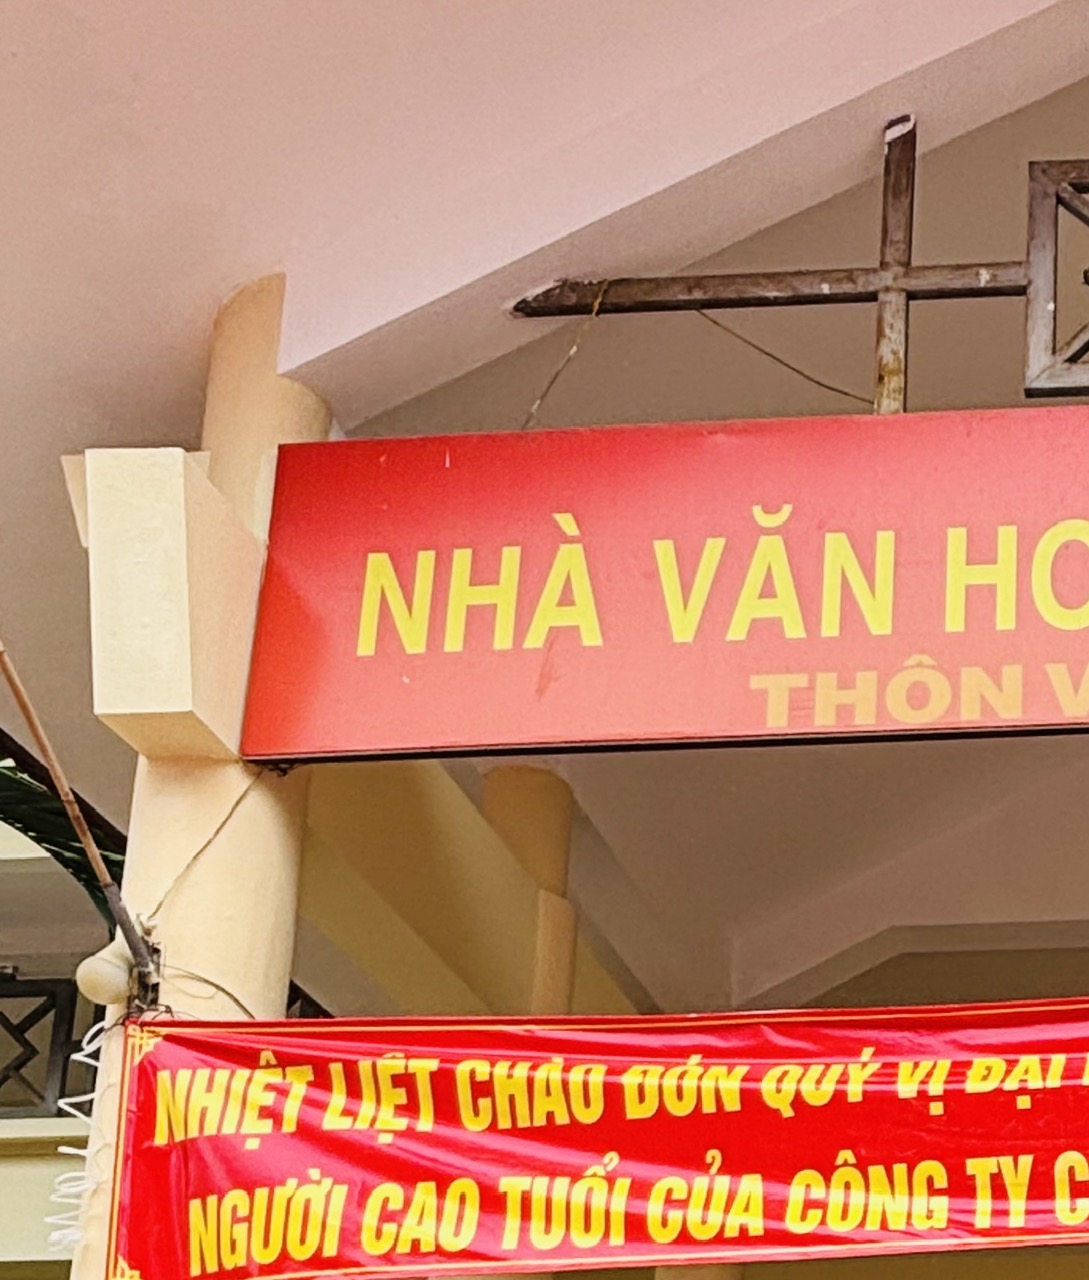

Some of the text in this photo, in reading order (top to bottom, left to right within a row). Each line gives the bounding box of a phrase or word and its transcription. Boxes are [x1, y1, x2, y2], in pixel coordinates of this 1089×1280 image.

[357, 513, 603, 657] NHÀ
[653, 504, 895, 643] VĂN
[750, 653, 1024, 728] THÔN
[153, 1049, 314, 1149] NHIỆT
[322, 1051, 440, 1144] LIỆT
[761, 1046, 880, 1119] QUÝ
[896, 1058, 952, 1116] VỊ
[964, 1053, 1065, 1110] ĐẠI
[188, 1167, 348, 1277] NGƯỜI
[360, 1177, 480, 1256] CAO
[497, 1149, 632, 1251] TUỔI
[646, 1148, 765, 1244] CỦA
[784, 1148, 949, 1236] CÔNG
[965, 1154, 1034, 1229] TY
